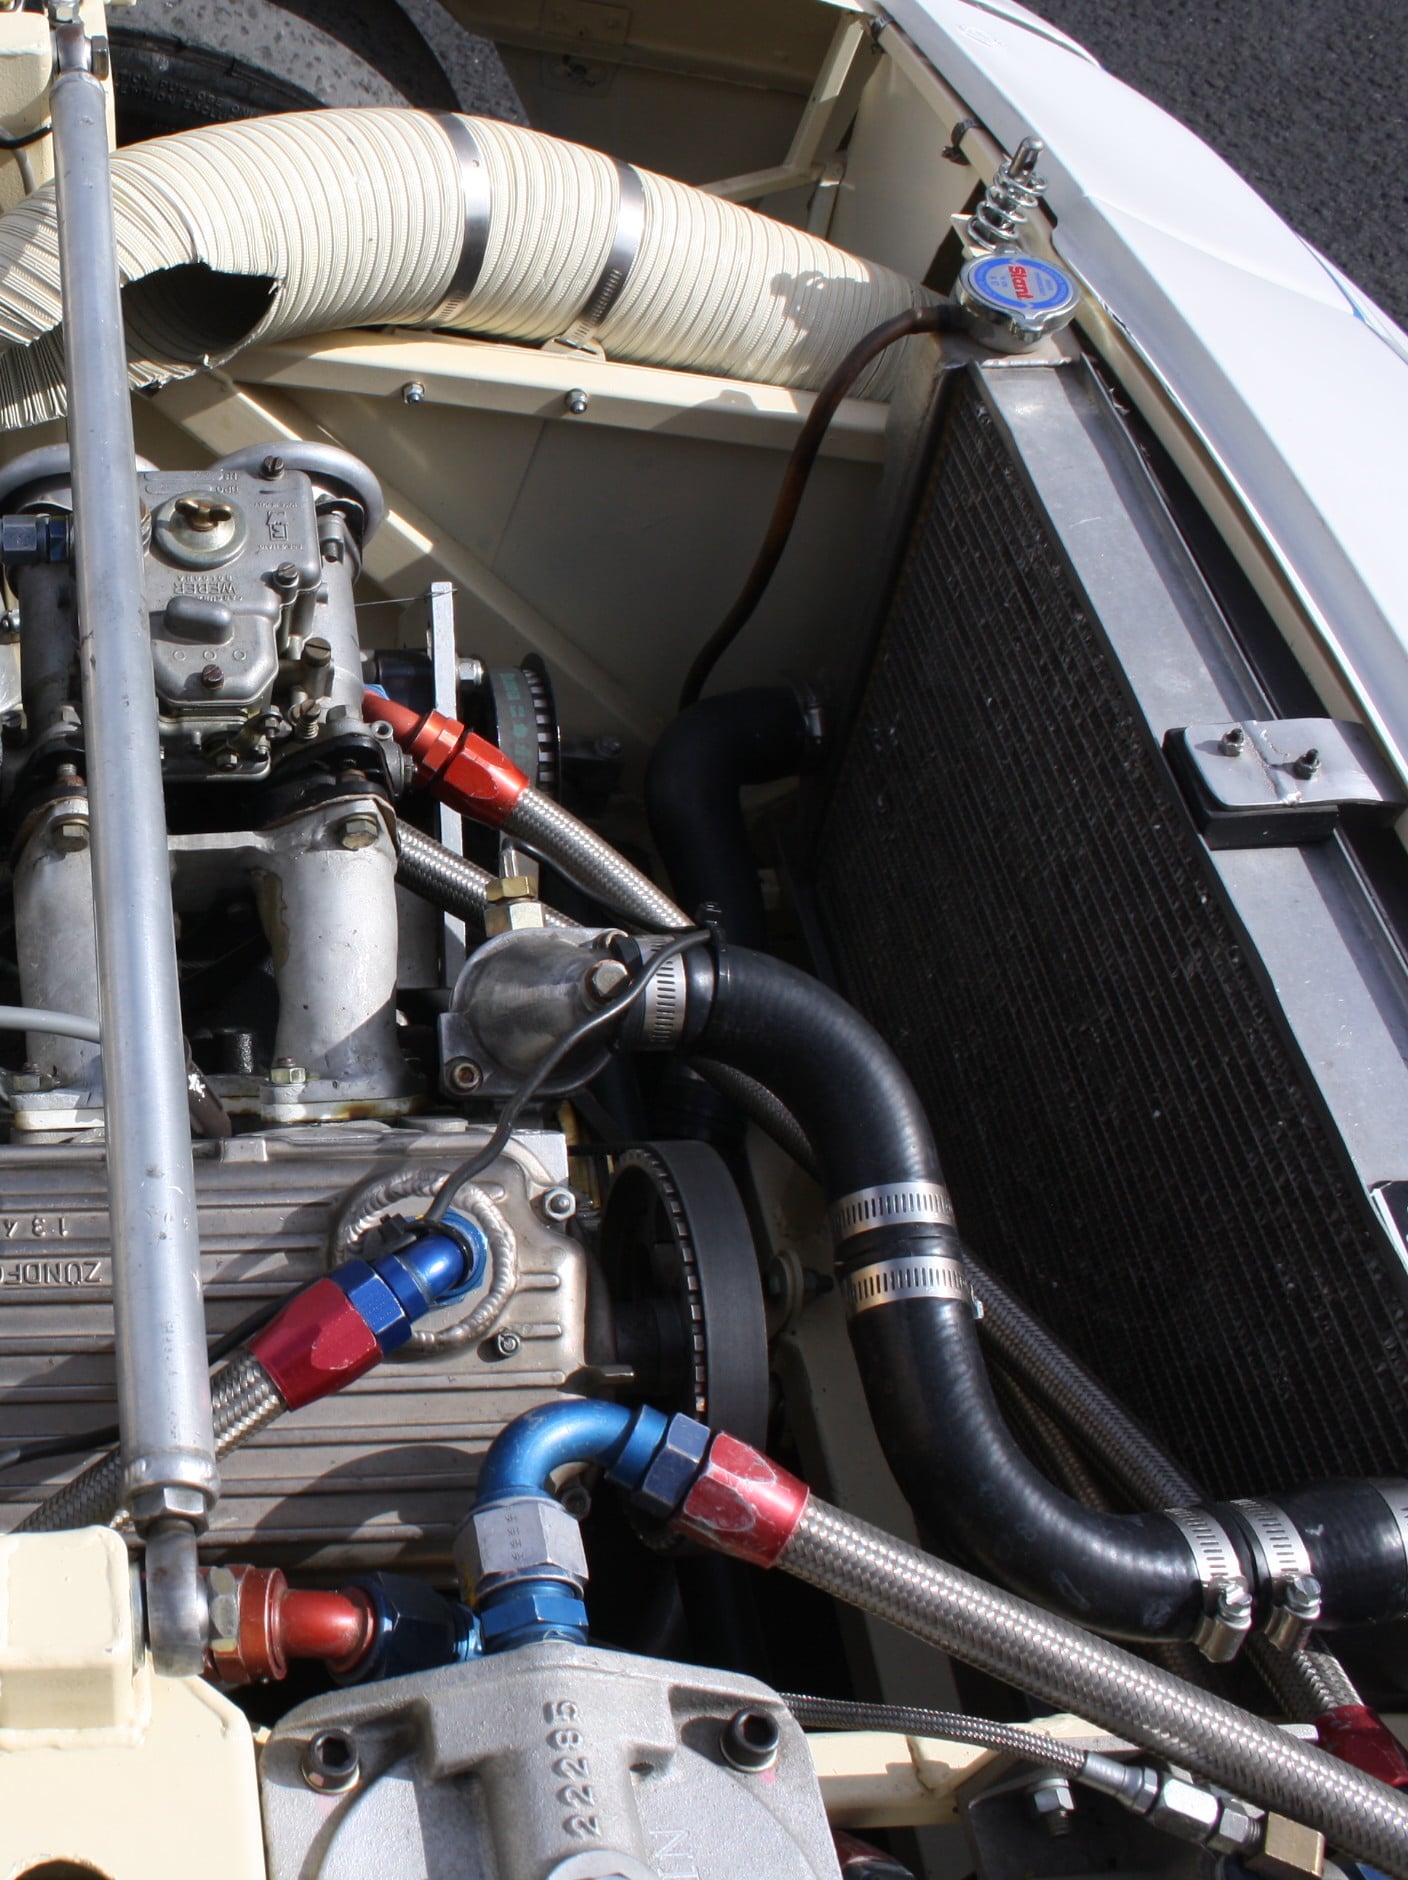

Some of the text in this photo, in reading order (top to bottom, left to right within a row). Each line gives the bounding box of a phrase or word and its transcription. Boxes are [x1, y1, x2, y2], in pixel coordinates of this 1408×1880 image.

[1008, 265, 1034, 301] Stant
[173, 582, 237, 595] WEBER
[543, 1700, 602, 1841] 22285
